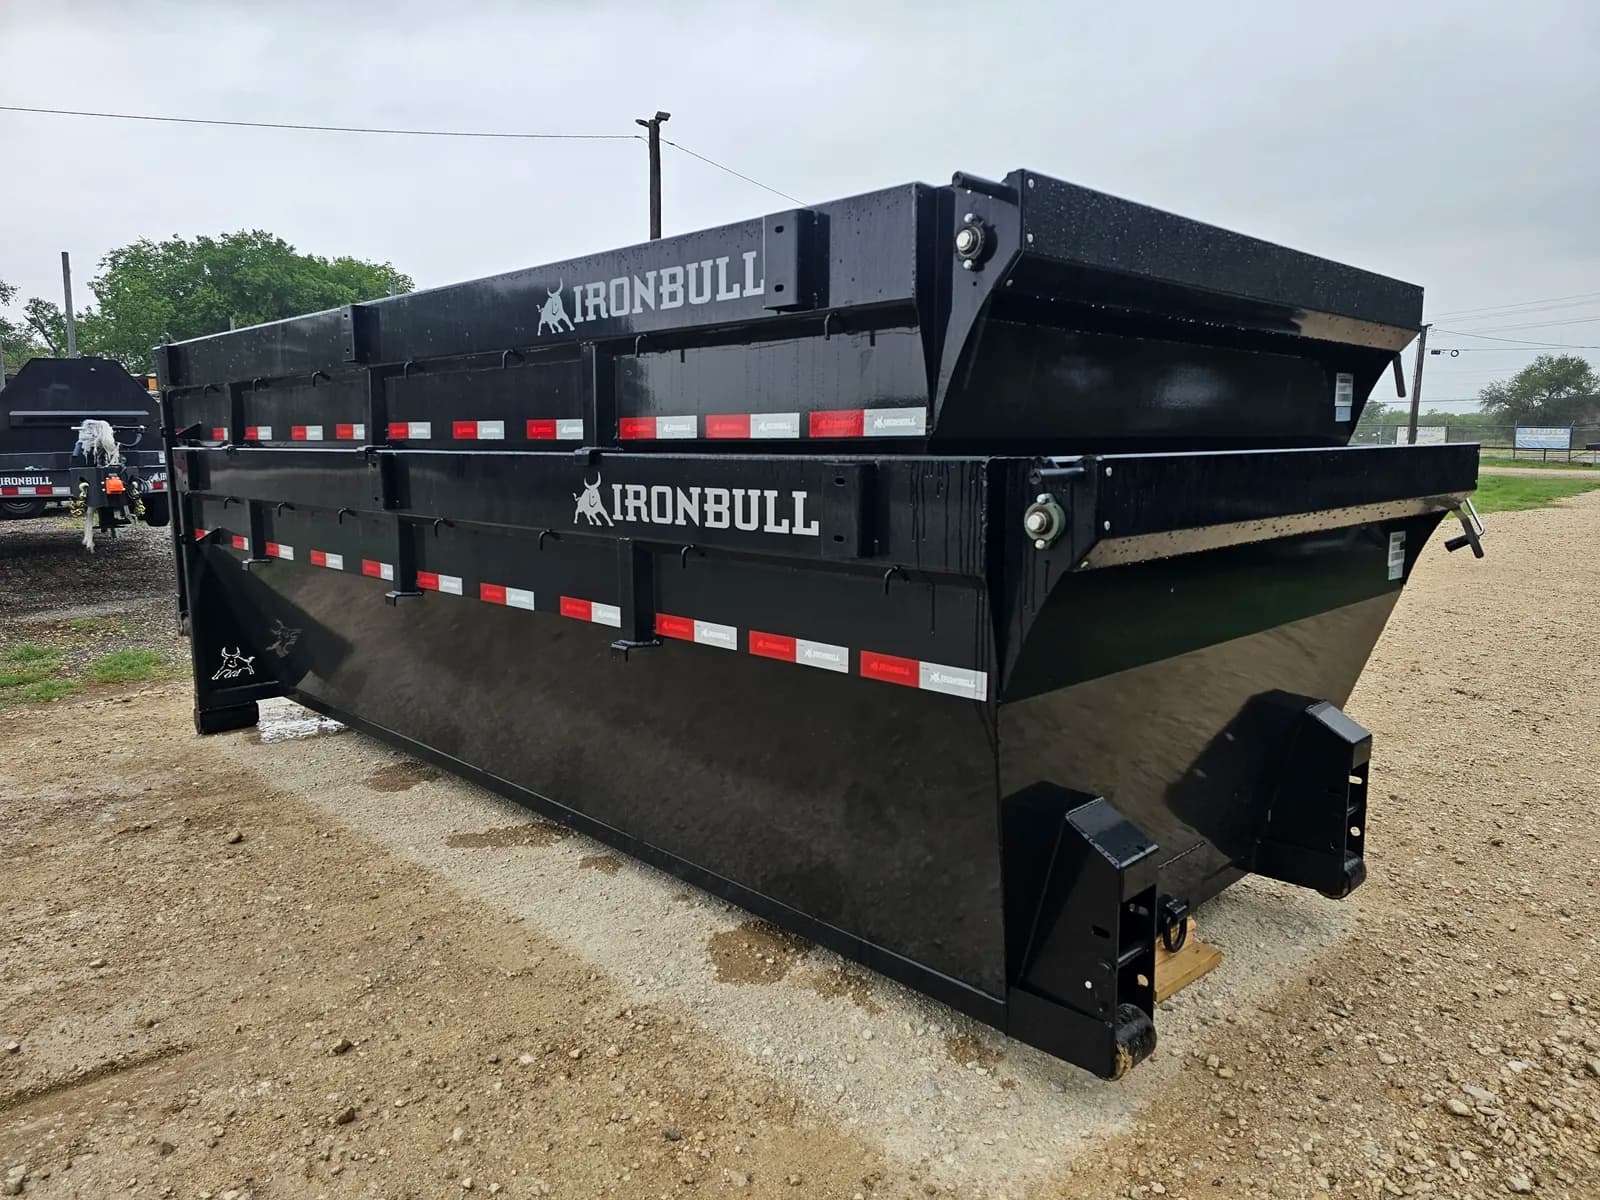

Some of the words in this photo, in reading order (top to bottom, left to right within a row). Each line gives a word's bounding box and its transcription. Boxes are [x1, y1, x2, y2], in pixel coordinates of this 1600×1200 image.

[573, 250, 765, 324] IRONBULL
[0, 476, 52, 486] IRONBULL
[611, 483, 820, 537] IRONBULL
